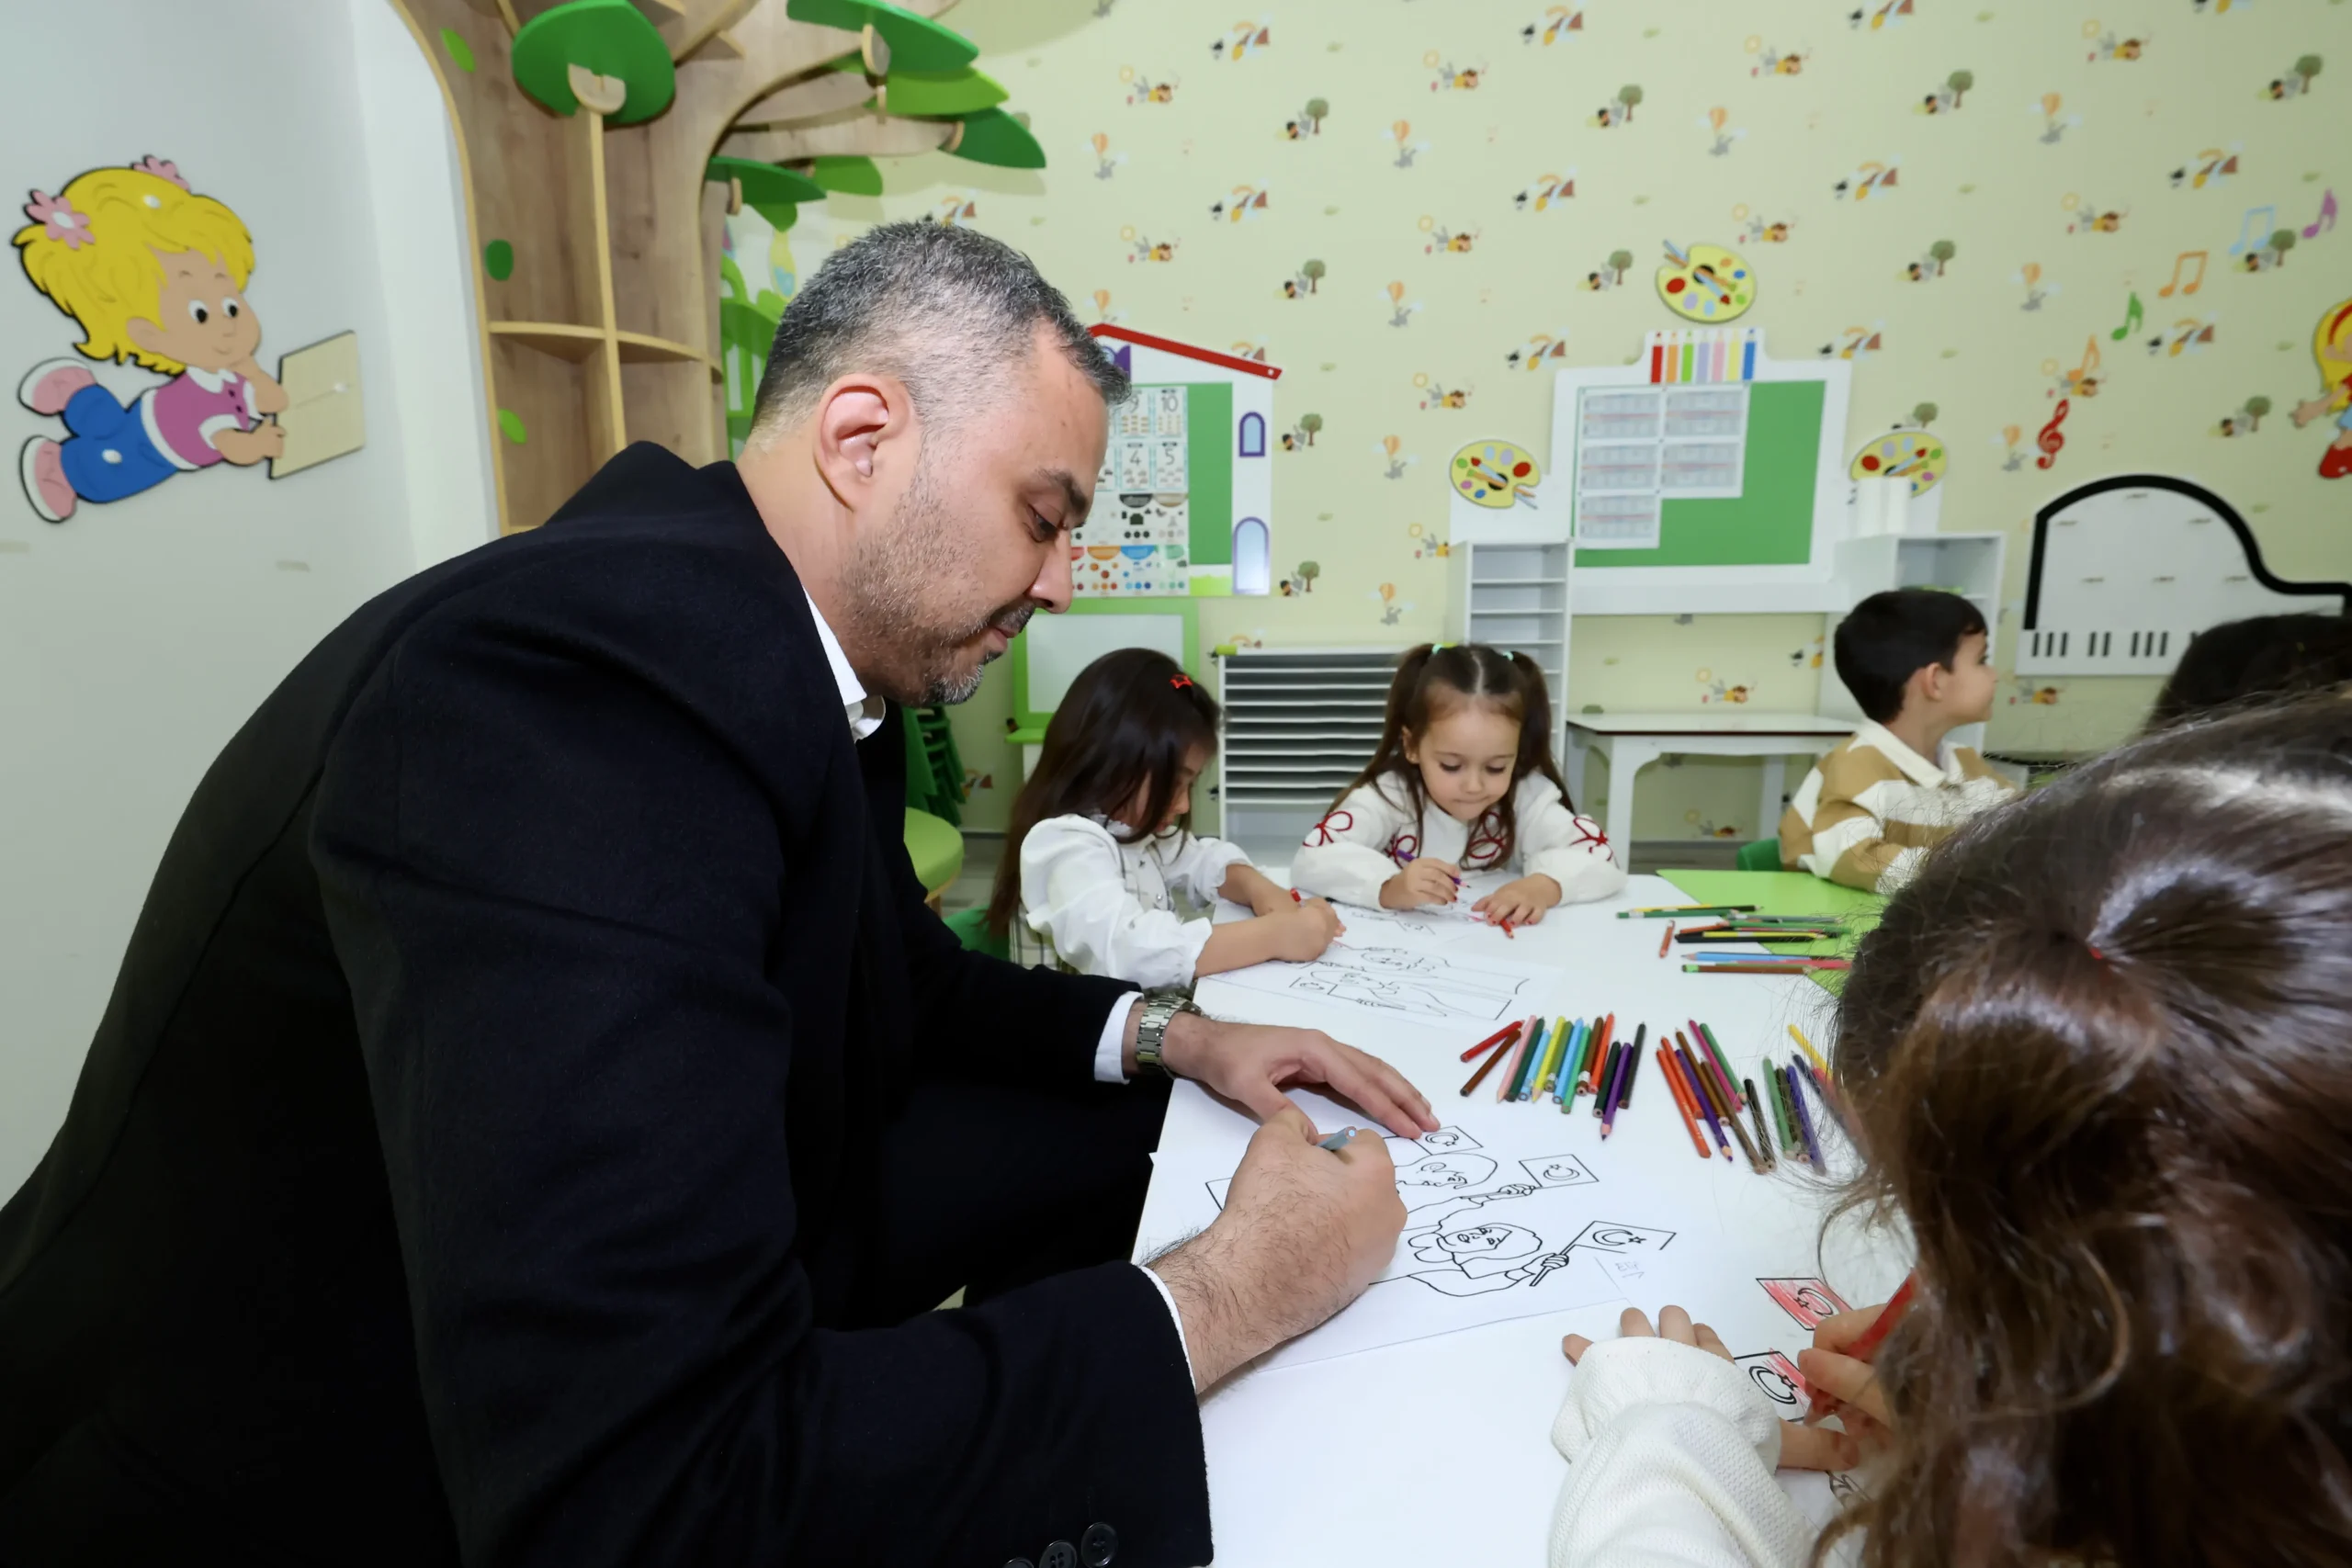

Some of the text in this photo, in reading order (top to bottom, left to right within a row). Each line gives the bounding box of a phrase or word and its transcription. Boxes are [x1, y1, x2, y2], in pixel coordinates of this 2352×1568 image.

[1161, 395, 1179, 412] 10
[1129, 449, 1141, 466] 4
[1164, 447, 1175, 466] 5
